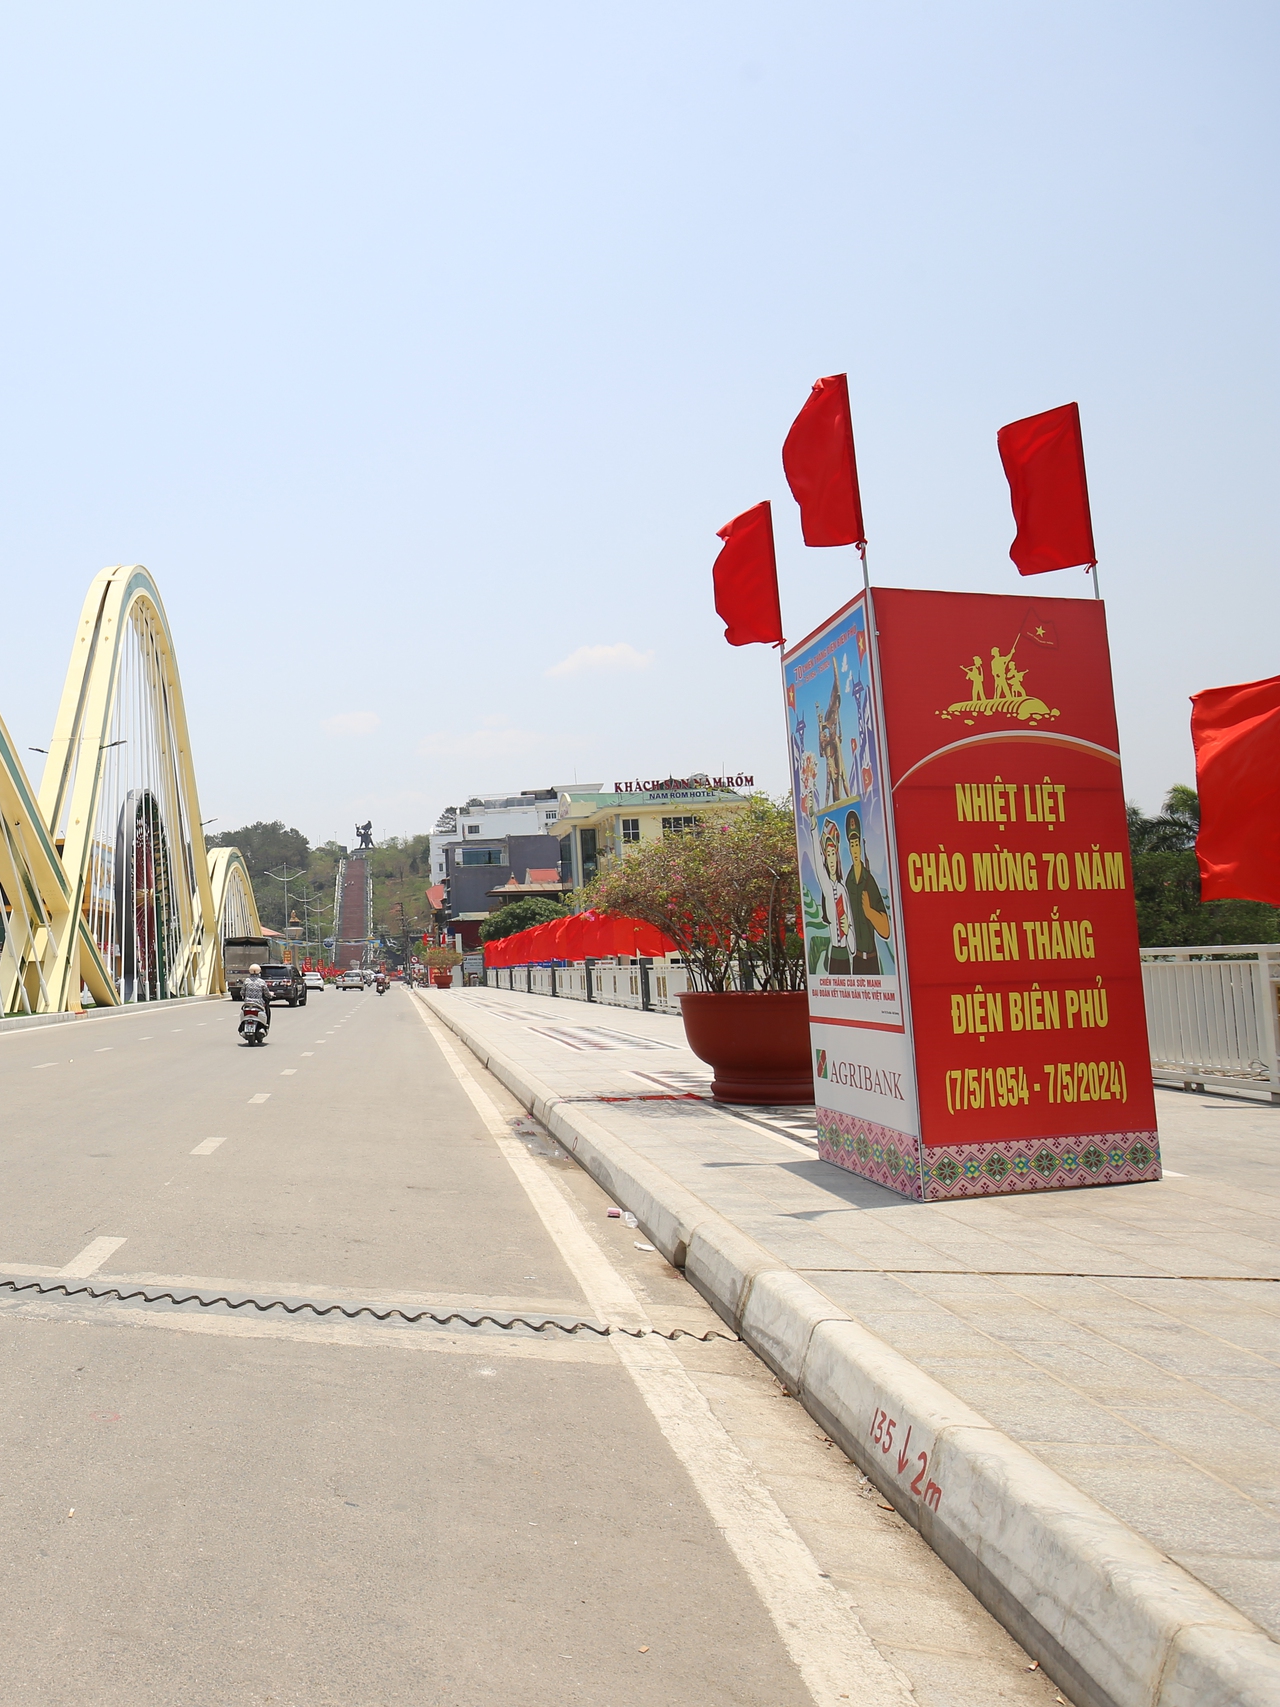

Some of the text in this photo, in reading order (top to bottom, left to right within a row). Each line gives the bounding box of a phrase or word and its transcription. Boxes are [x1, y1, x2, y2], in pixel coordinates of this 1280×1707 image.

[614, 778, 661, 793] KHÁCH
[649, 791, 669, 800] NAM
[689, 790, 716, 799] HOTEL
[955, 775, 1066, 831] NHIỆT LIỆT
[907, 843, 1126, 893] CHÀO MỪNG 70 NĂM
[952, 906, 1095, 963] CHIẾN THẮNG
[819, 976, 832, 987] CHIẾN
[832, 976, 846, 987] THẮNG
[846, 976, 856, 987] CỦA
[866, 978, 882, 990] MẠNH
[861, 990, 871, 1001] TỘC
[871, 990, 883, 1002] VIỆT
[883, 992, 896, 1001] NAM
[950, 975, 1109, 1042] ĐIỆN BIÊN PHỦ
[830, 1060, 905, 1101] AGRIBANK
[945, 1060, 1128, 1115] (7/5/1954 - 7/5/2024)
[869, 1407, 942, 1513] 135 2m
